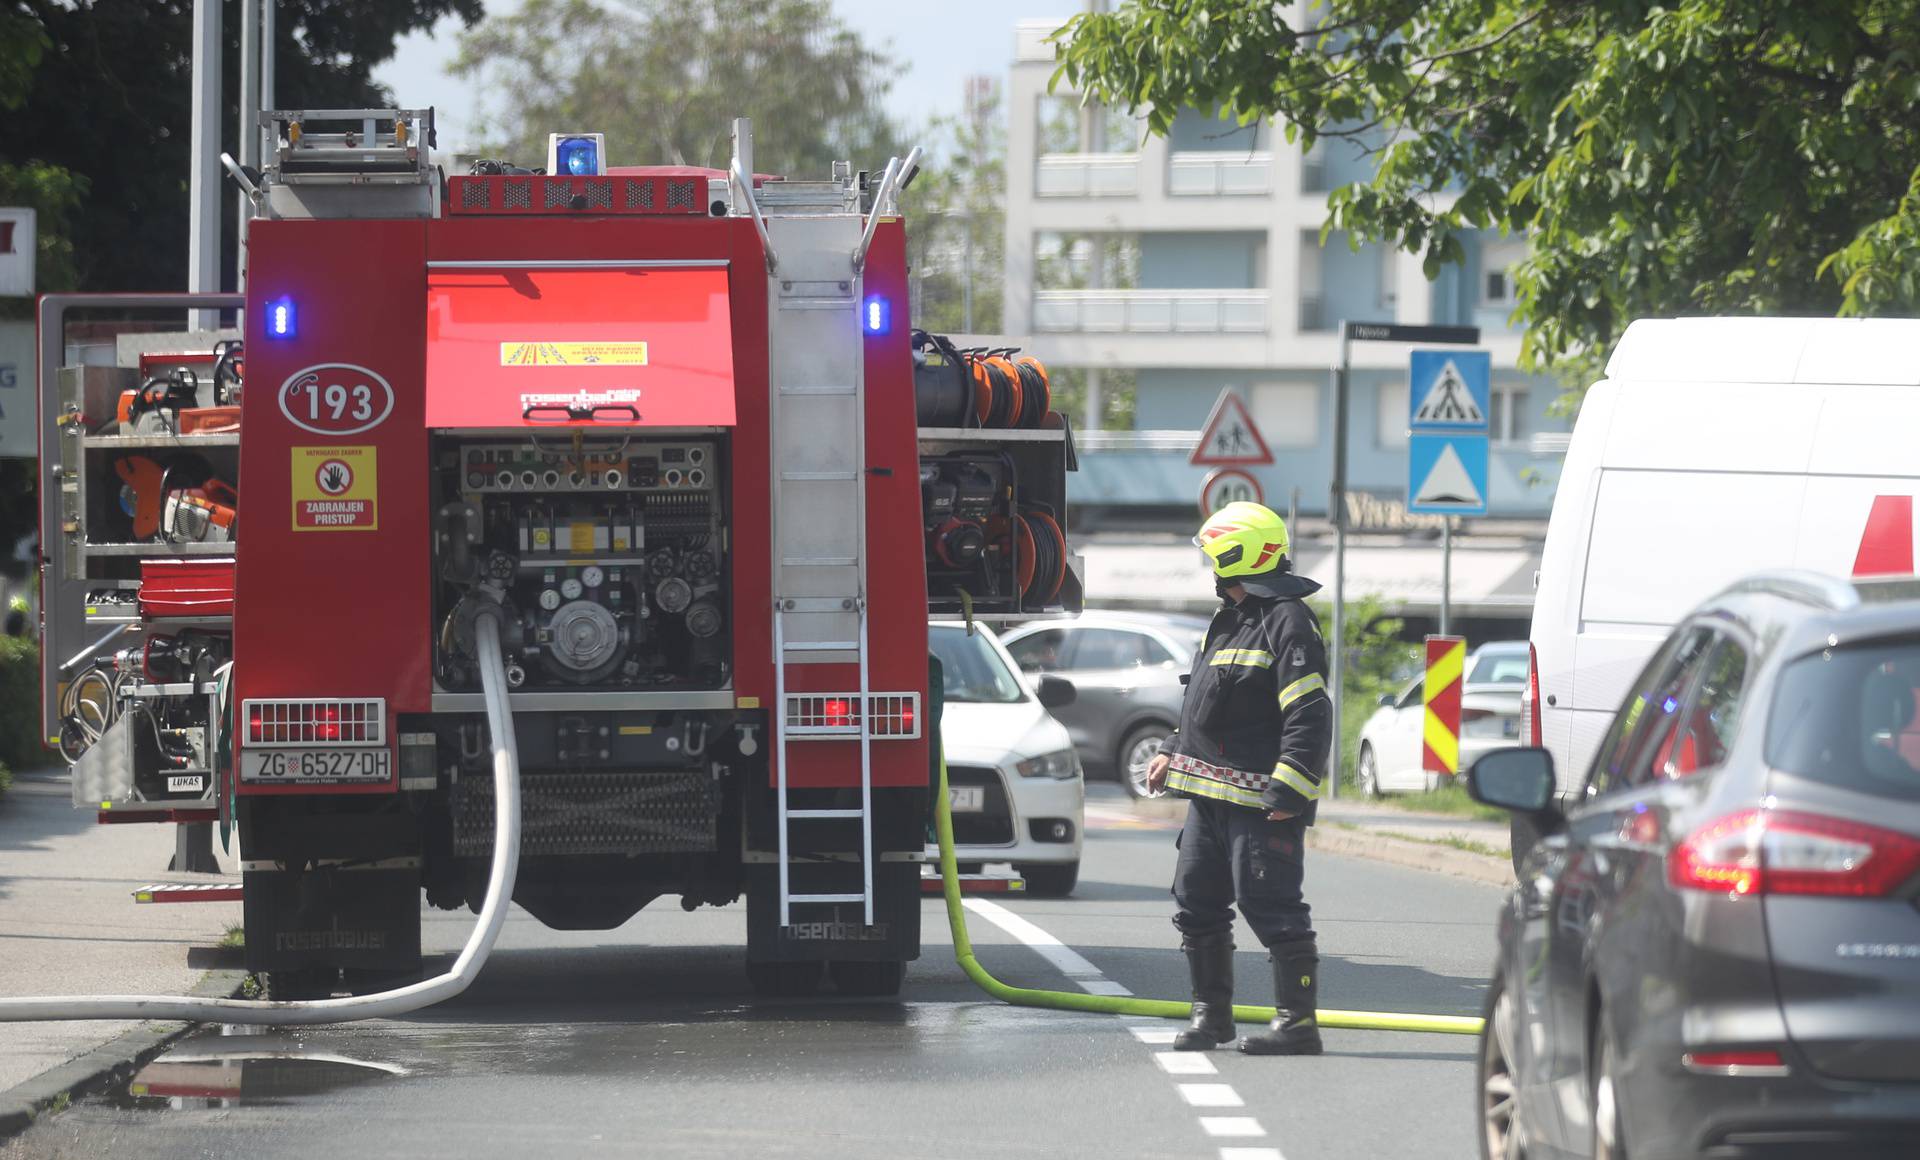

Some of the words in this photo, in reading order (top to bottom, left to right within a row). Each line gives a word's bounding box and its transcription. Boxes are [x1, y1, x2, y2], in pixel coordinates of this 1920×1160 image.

[305, 384, 372, 420] 193
[306, 502, 364, 513] ZABRANJEN
[314, 514, 357, 525] PRISTUP
[258, 752, 286, 777] ZG
[172, 776, 200, 787] LUKAS
